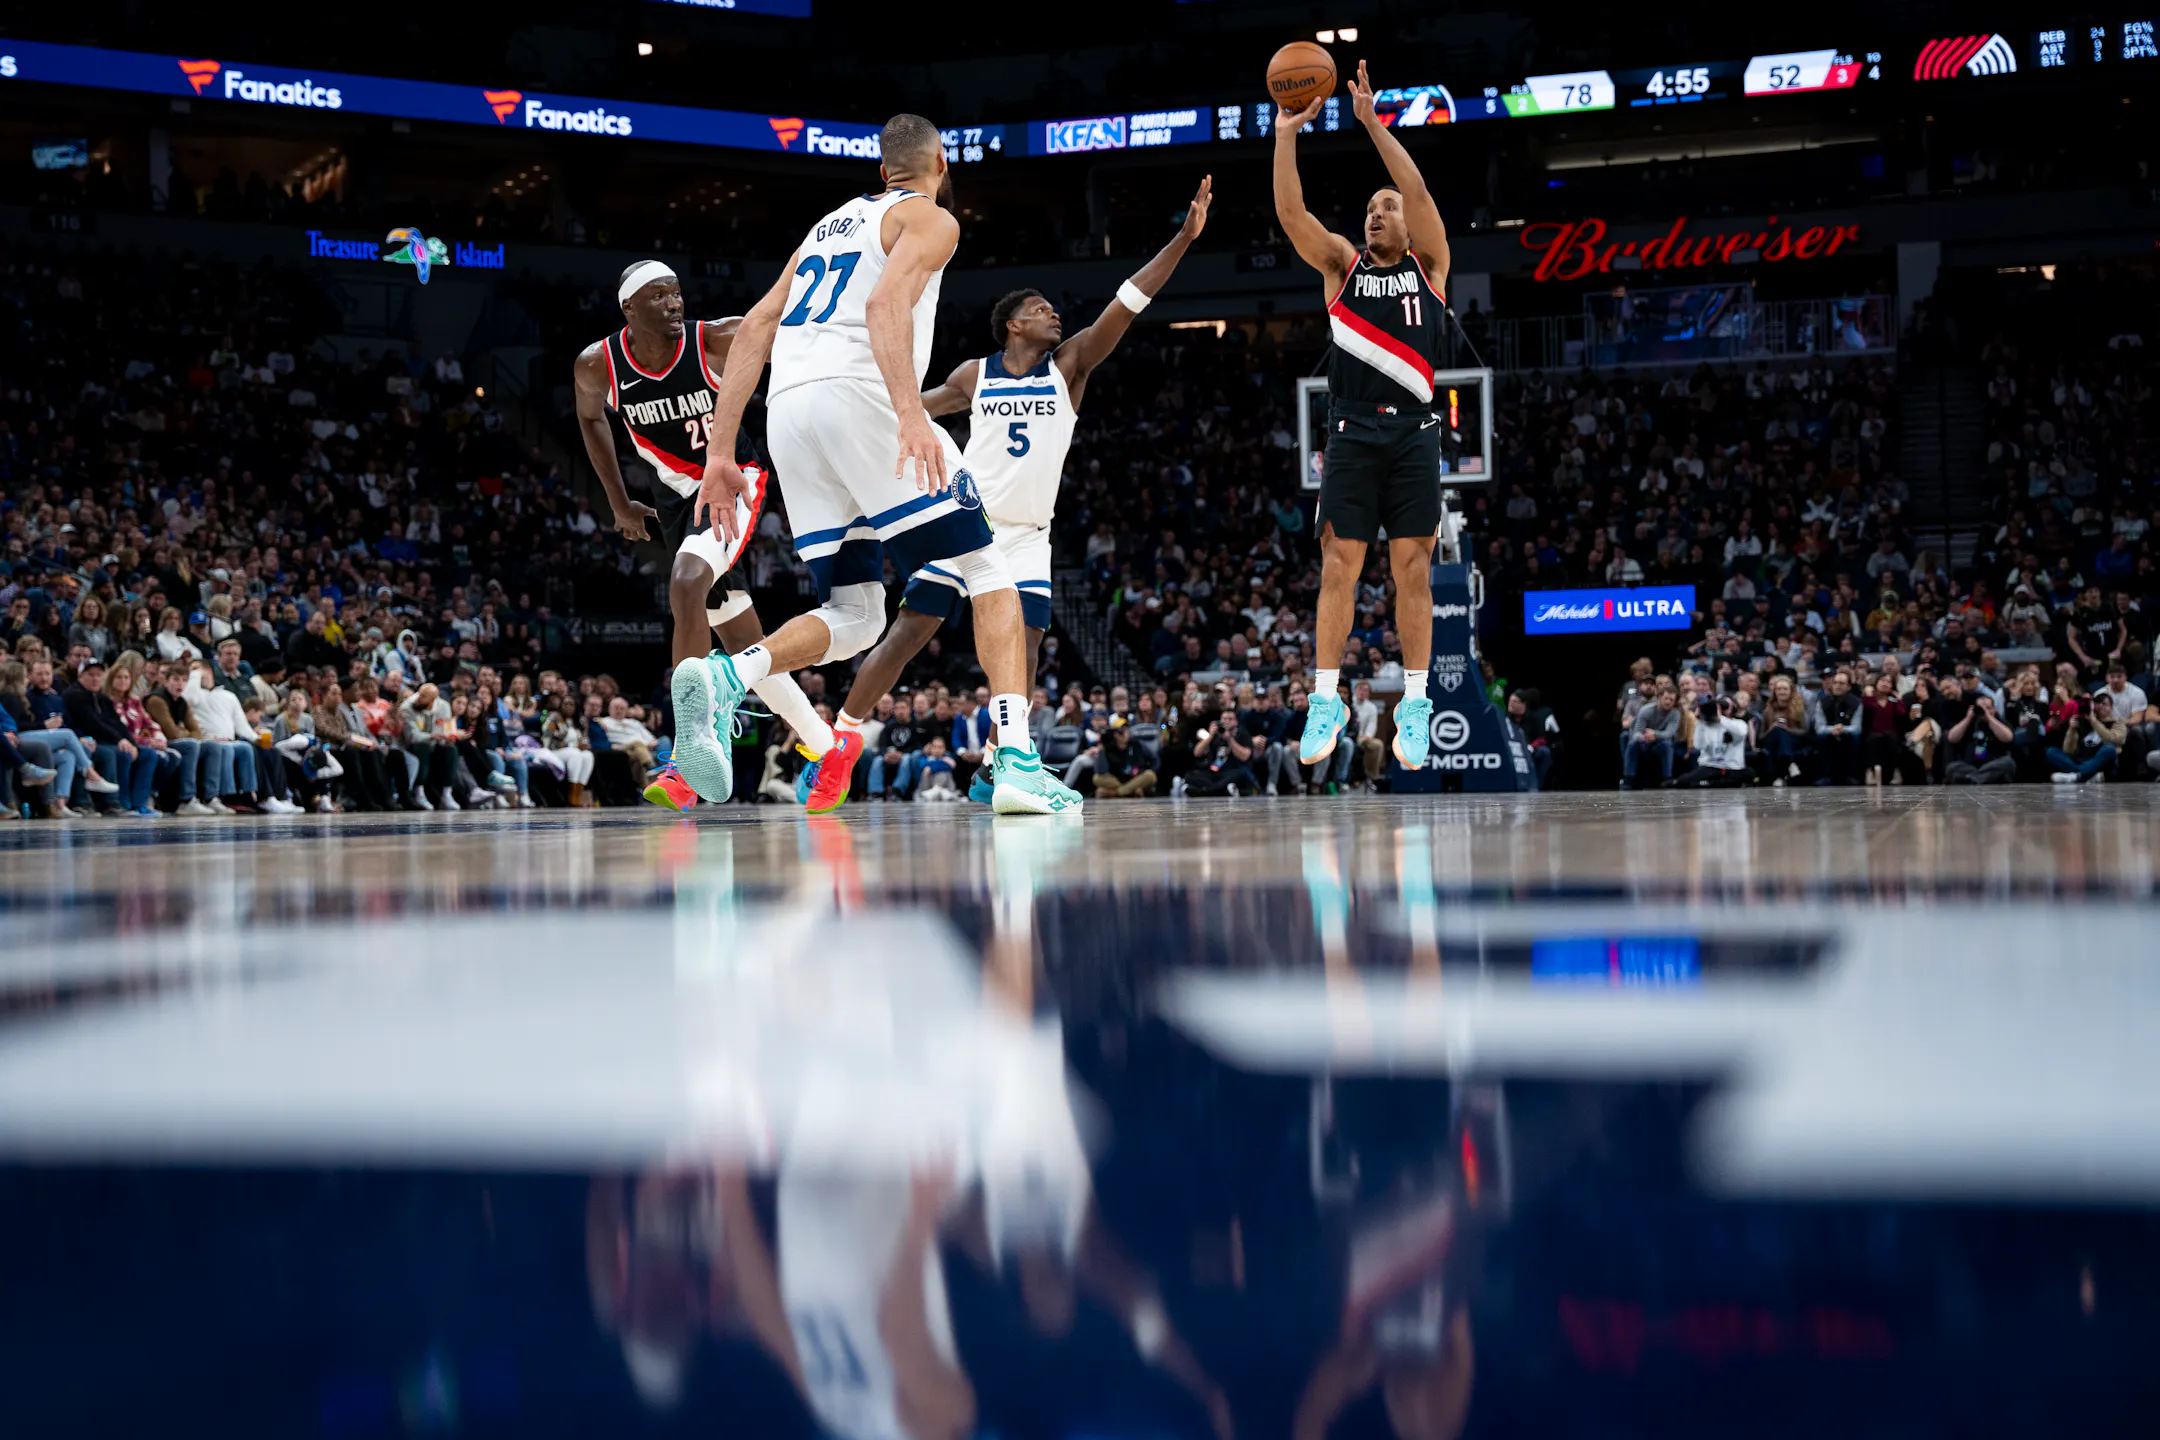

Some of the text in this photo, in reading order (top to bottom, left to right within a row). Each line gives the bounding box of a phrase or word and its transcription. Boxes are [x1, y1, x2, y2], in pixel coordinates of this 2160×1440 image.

[2040, 21, 2154, 43] REB 24 FG%
[2040, 42, 2066, 55] AST
[2125, 33, 2153, 46] FT%
[1866, 51, 1881, 63] TO
[2041, 54, 2066, 67] STL
[2123, 44, 2158, 59] 3PT%
[1271, 76, 1316, 92] Wilson
[1646, 67, 1710, 96] 4:55
[1769, 65, 1801, 89] 52
[1837, 65, 1880, 83] 3 4
[225, 70, 342, 109] Fanatics
[1484, 87, 1498, 98] TO
[1561, 84, 1593, 107] 78
[1218, 106, 1241, 118] REB
[1486, 98, 1528, 114] 5 2
[525, 99, 632, 136] Fanatics
[1218, 117, 1240, 128] AST
[807, 127, 882, 159] Fanati
[940, 128, 983, 146] AC 77
[989, 135, 1001, 151] 4
[1047, 117, 1125, 153] KFAN
[1219, 128, 1240, 139] STL
[943, 145, 983, 163] HI 96
[305, 230, 505, 269] Treasure Island
[1520, 216, 1860, 282] Budweiser
[780, 251, 862, 326] 27
[1354, 271, 1419, 298] PORTLAND
[1401, 295, 1422, 326] 11
[622, 389, 713, 426] PORTLAND
[981, 401, 1056, 417] WOLVES
[684, 411, 714, 450] 26
[1006, 422, 1030, 458] 5
[1533, 599, 1685, 622] Michelob ULTRA
[1433, 662, 1468, 673] CLINIC
[1436, 654, 1465, 663] MAYO
[1400, 753, 1501, 771] MOTO
